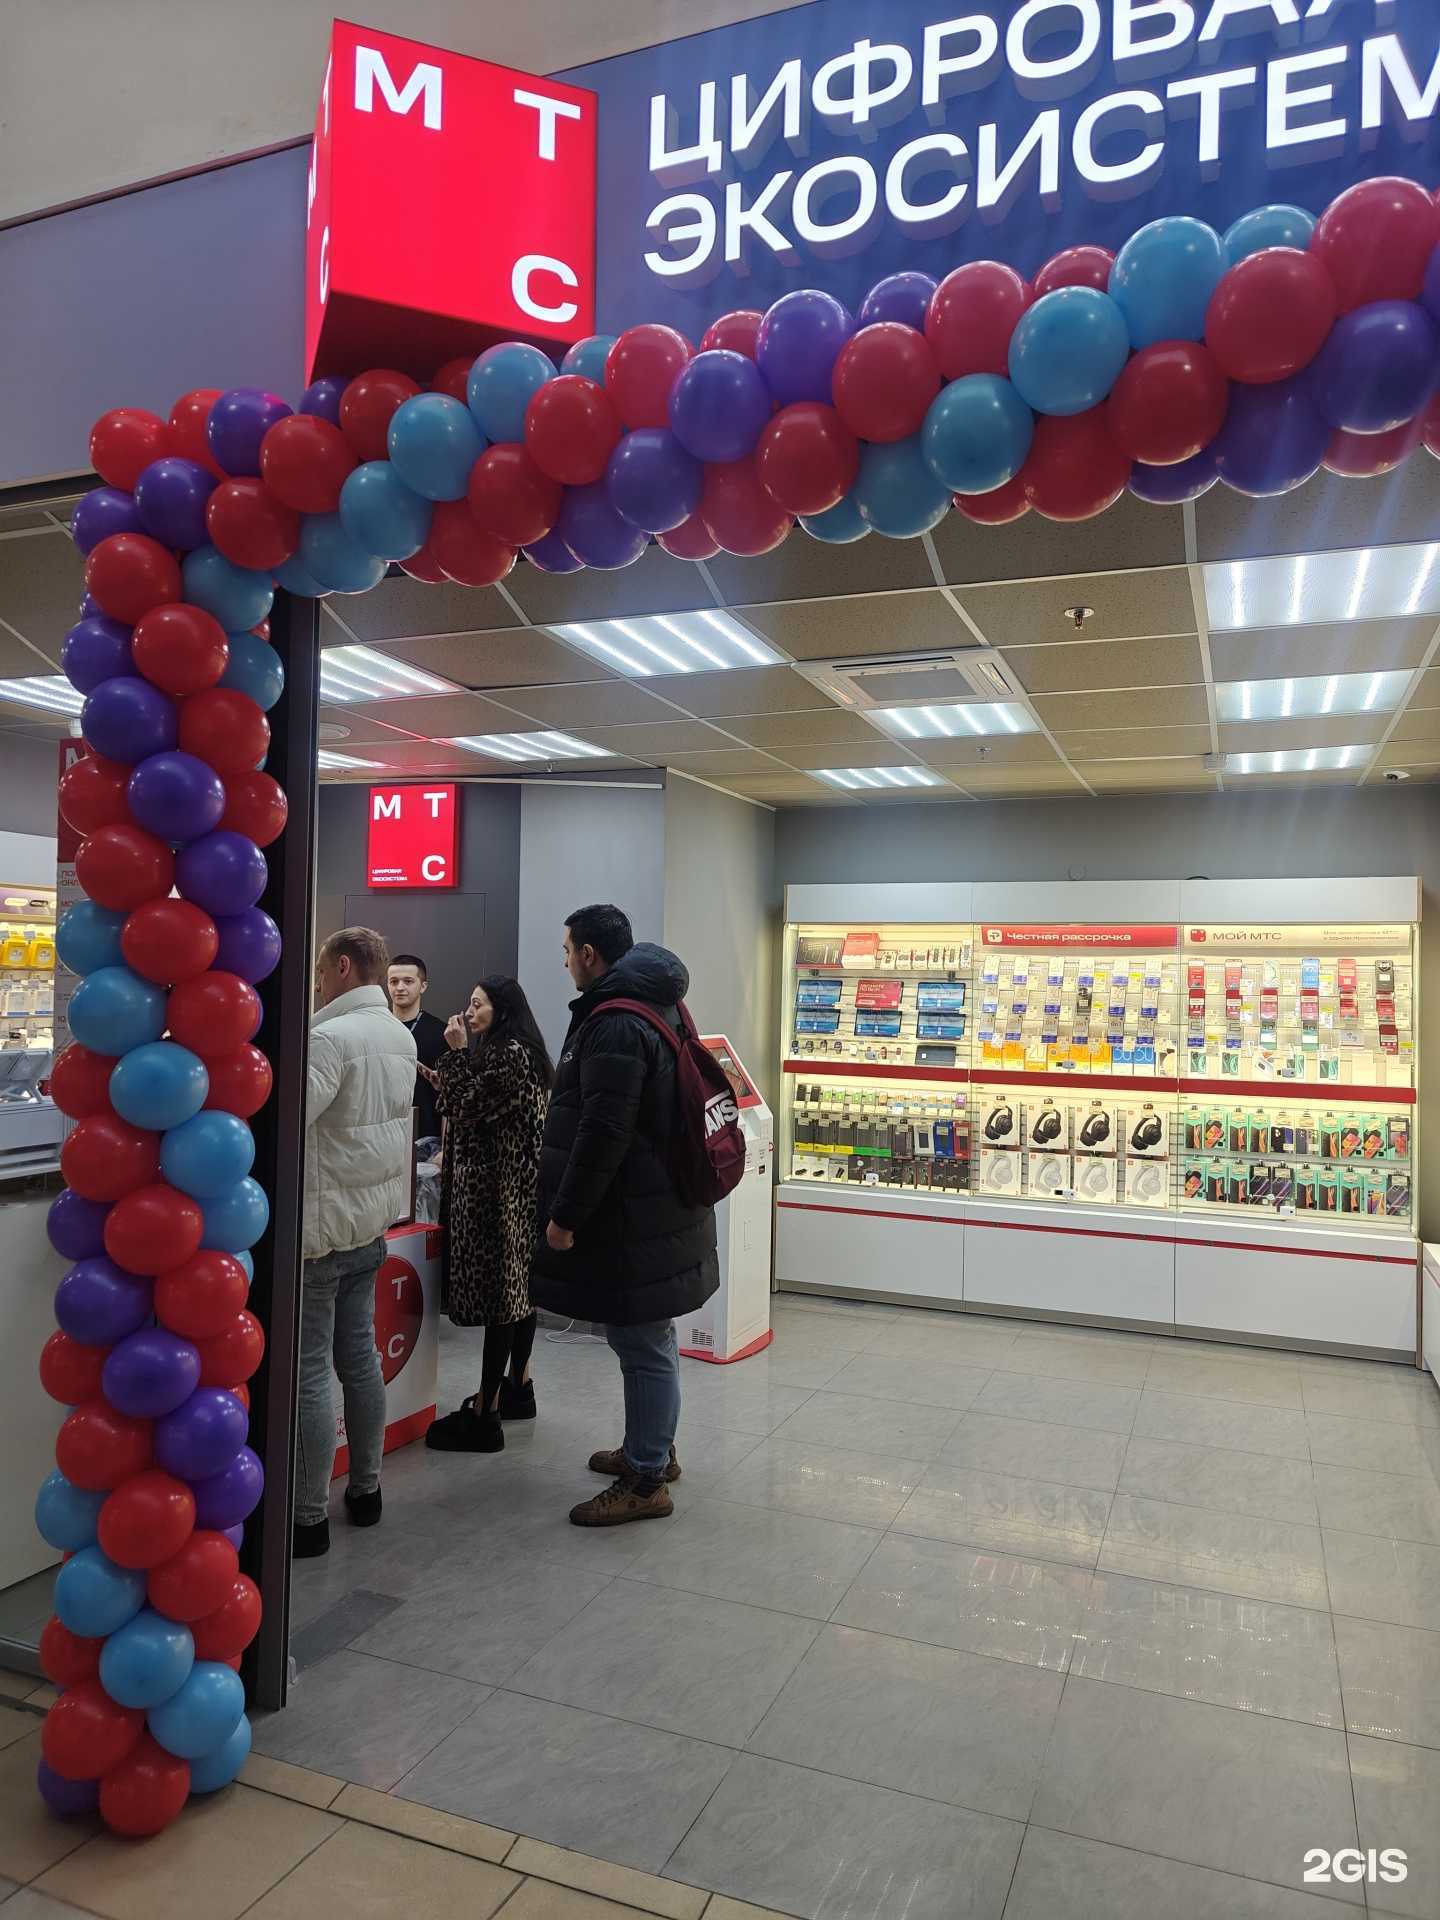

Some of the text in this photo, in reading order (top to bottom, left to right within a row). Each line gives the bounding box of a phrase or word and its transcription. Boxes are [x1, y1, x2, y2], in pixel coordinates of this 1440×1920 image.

[650, 0, 1395, 173] ЦИФРОВ
[1007, 931, 1131, 943] Честная рассрочка
[1212, 930, 1282, 940] МОЙ МТС
